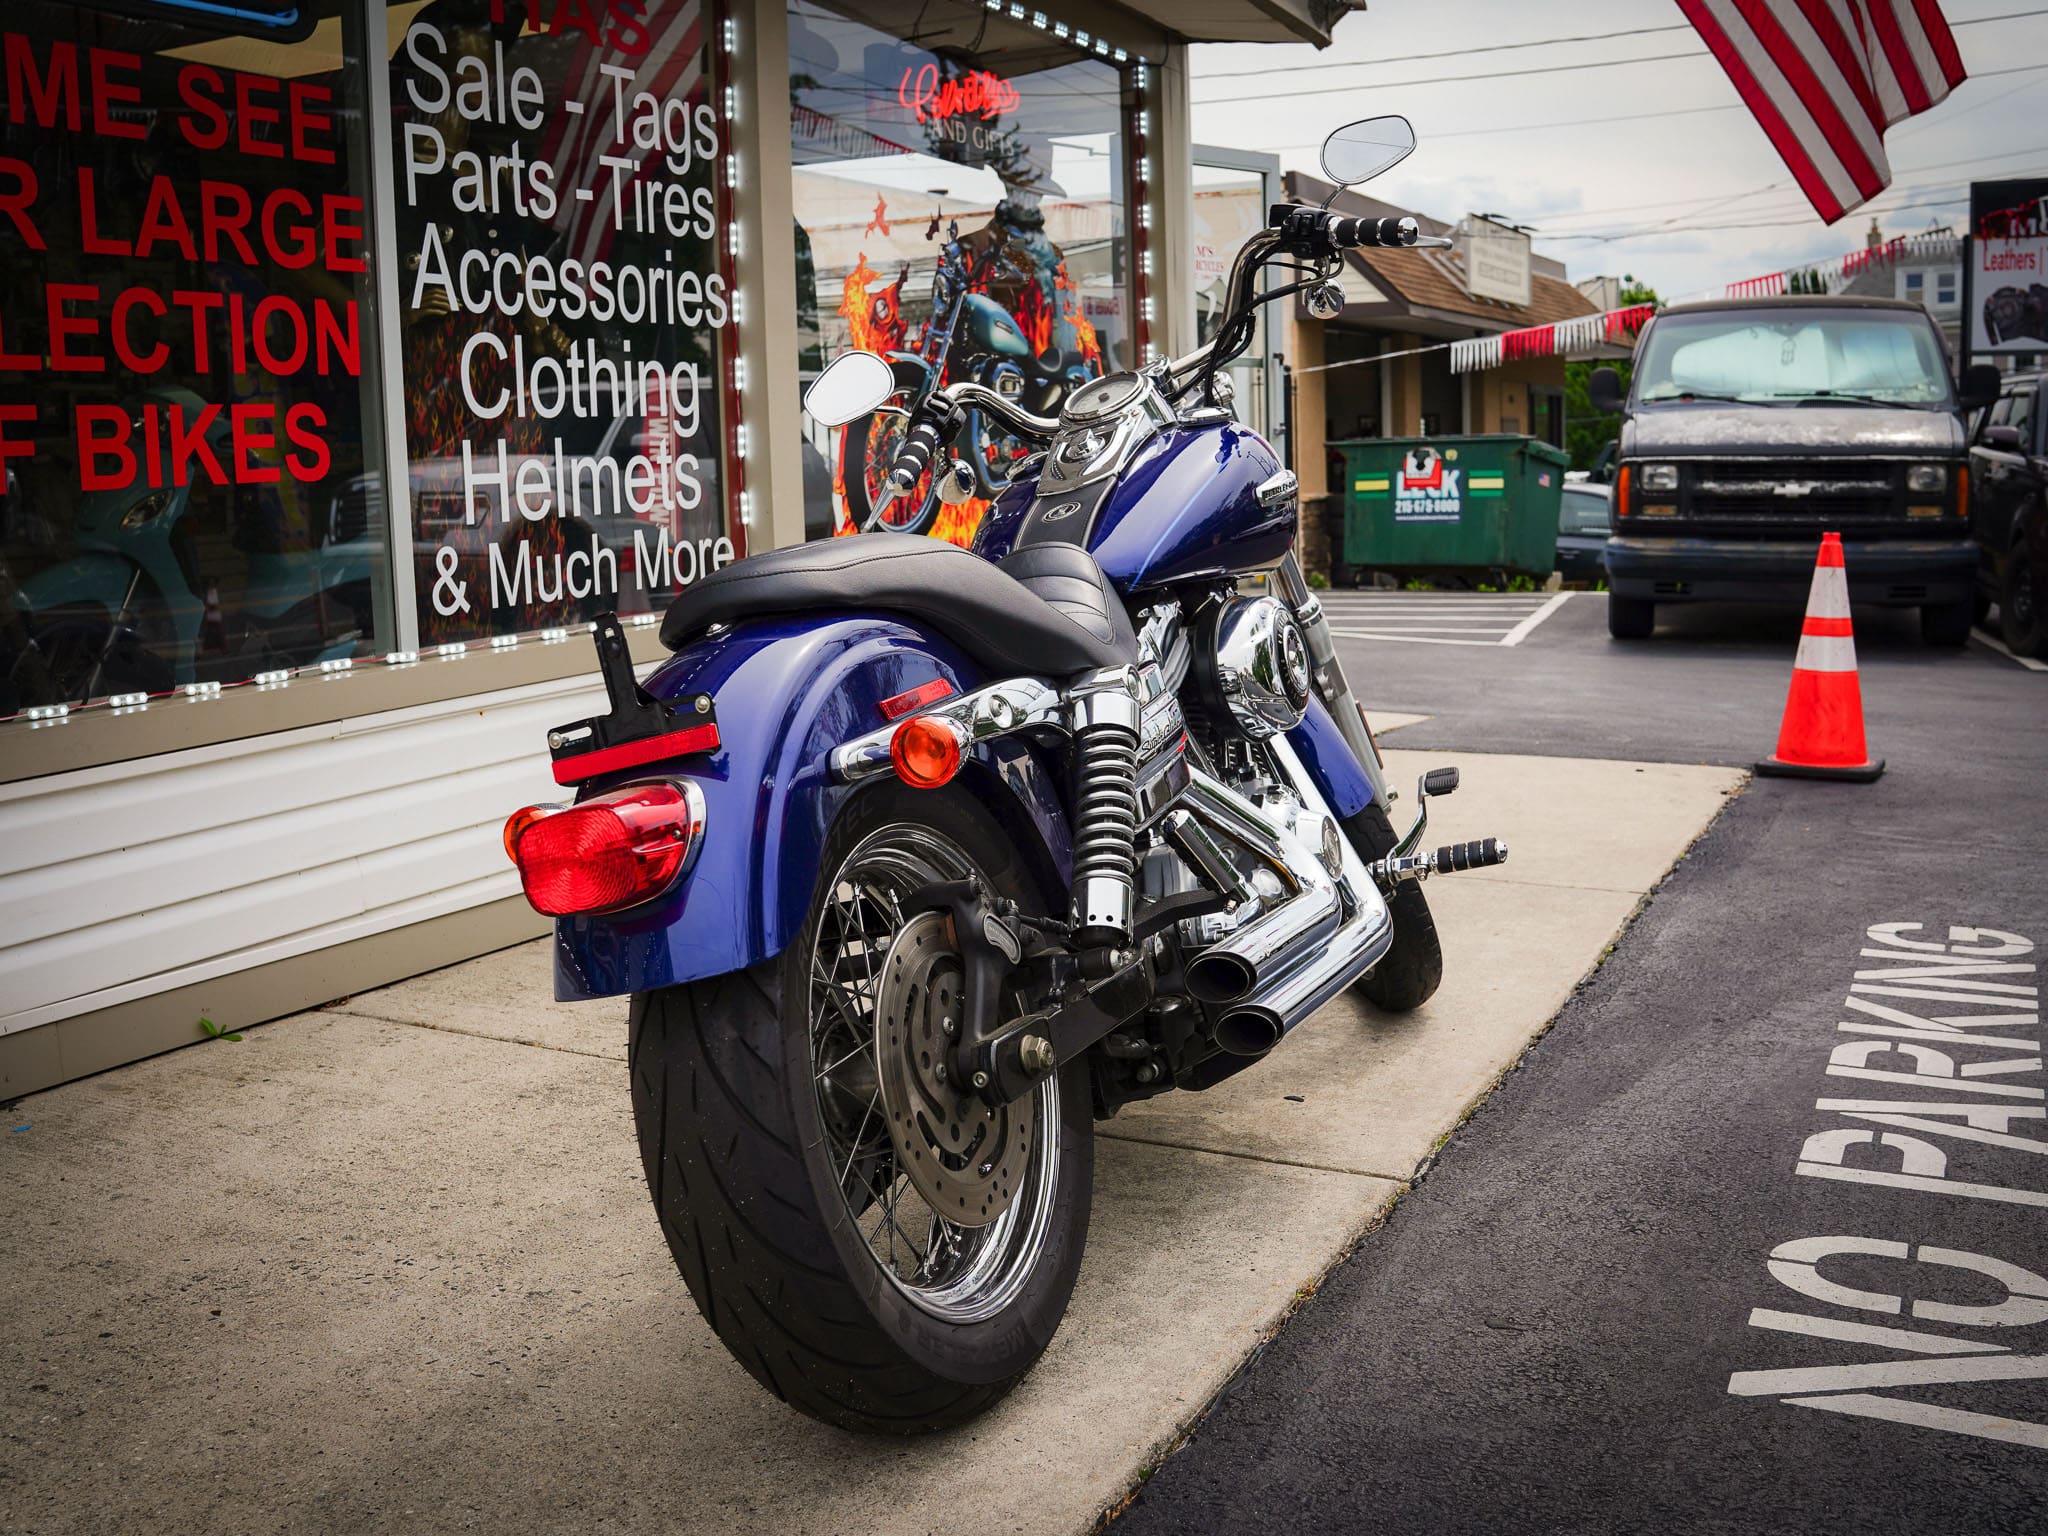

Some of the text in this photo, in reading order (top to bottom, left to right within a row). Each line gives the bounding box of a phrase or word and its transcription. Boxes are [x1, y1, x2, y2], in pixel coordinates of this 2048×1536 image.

[4, 32, 336, 165] ME SEE
[405, 21, 545, 131] Sale
[599, 63, 719, 175] Tags
[932, 118, 1014, 156] AND GIFTS
[0, 155, 368, 273] R LARGE
[404, 122, 557, 220] Parts
[599, 155, 716, 240] Tires
[411, 222, 728, 329] Accessories
[1983, 248, 2036, 272] Leathers
[0, 283, 362, 376] LECTION
[461, 331, 700, 438] Clothing
[76, 402, 331, 491] BIKES
[463, 437, 702, 527] Helmets
[432, 525, 736, 616] & Much More
[1727, 921, 2048, 1449] NO PARKING
